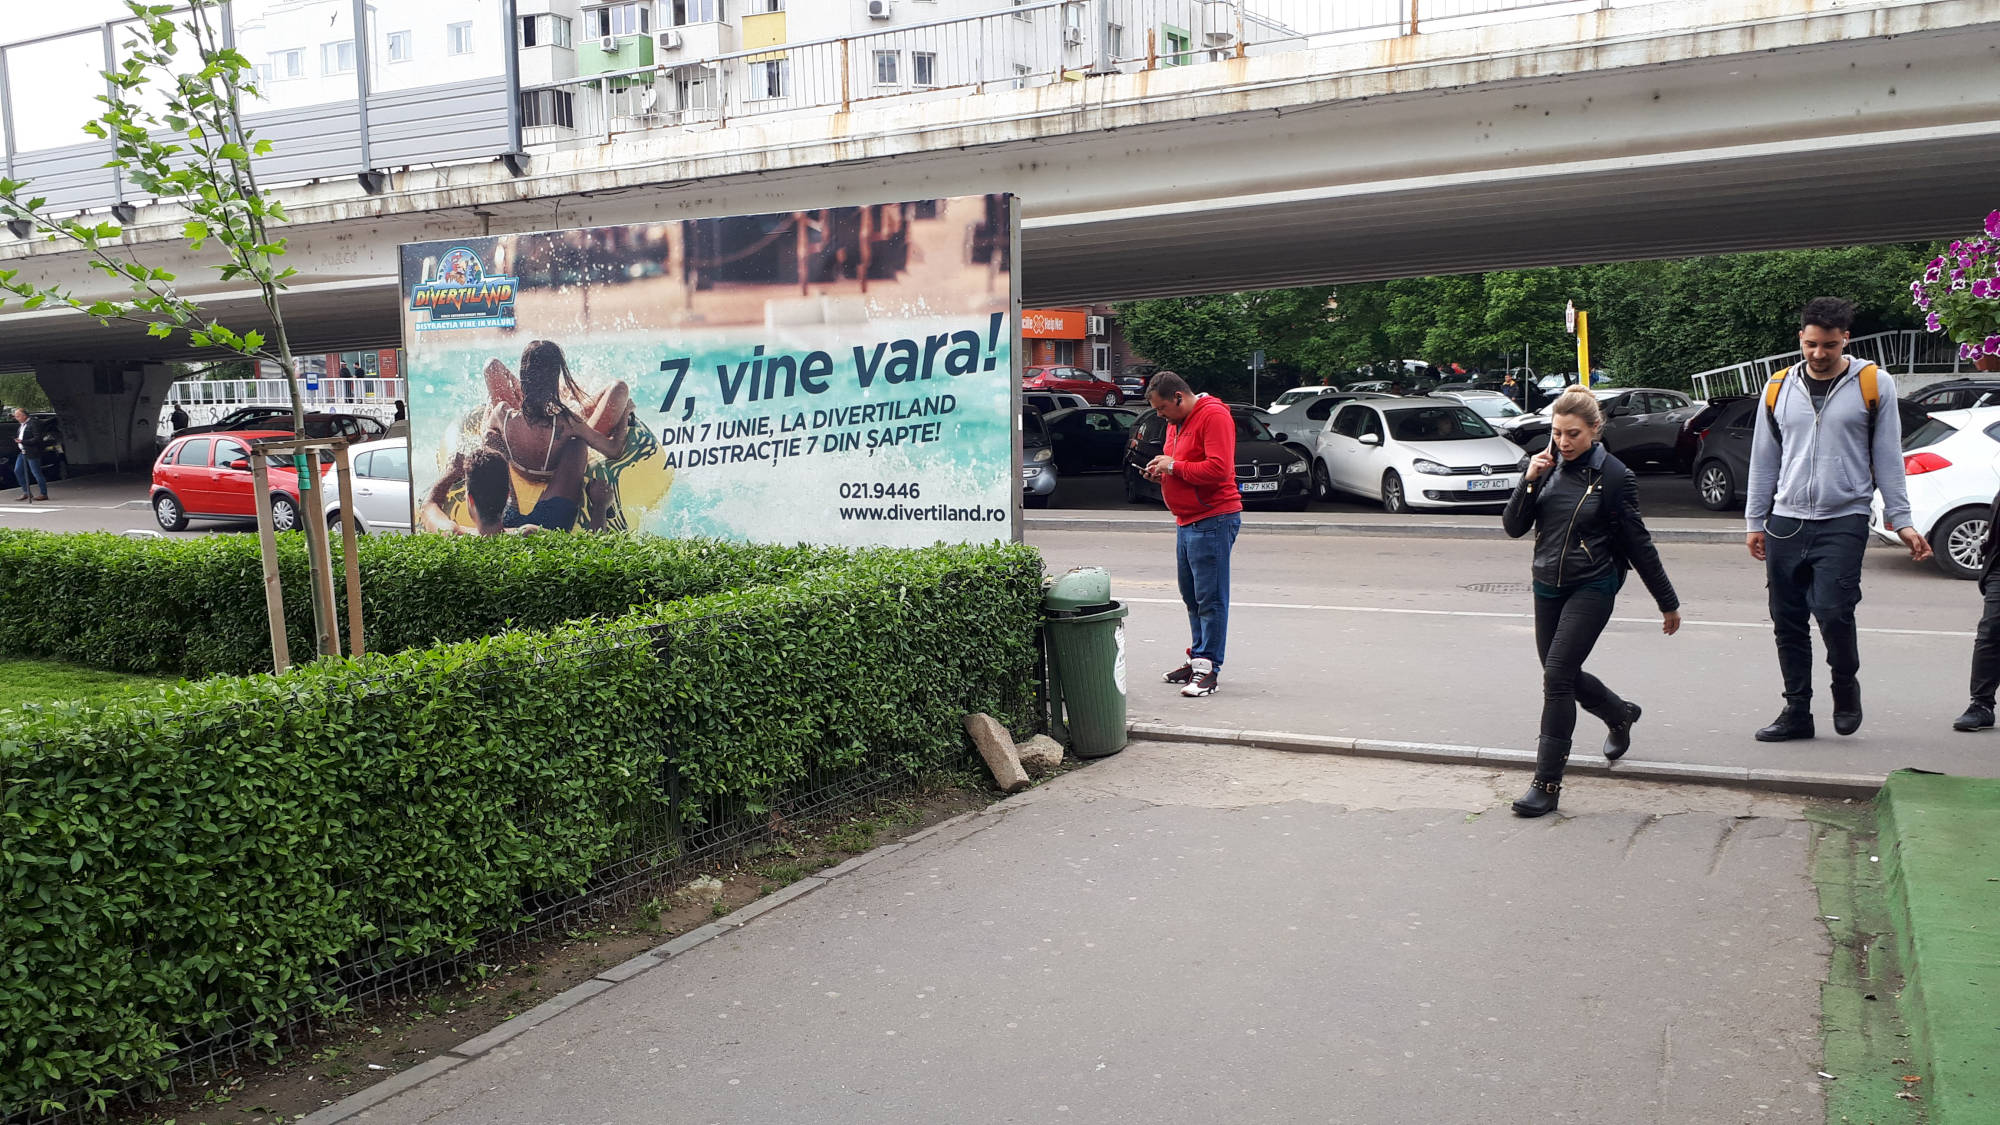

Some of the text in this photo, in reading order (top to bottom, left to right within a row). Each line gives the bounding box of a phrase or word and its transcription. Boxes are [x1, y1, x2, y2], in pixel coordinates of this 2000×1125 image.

[416, 283, 512, 311] DIVERTILAND
[659, 311, 1004, 422] 7, vine vara!
[662, 394, 956, 447] DIN 7 IUNIE, LA DIVERTILAND
[663, 421, 942, 470] AI DISTRACȚIE 7 DIN ȘAPTE!
[839, 482, 920, 499] 021.9446
[1481, 480, 1490, 488] 27
[839, 503, 1006, 522] www.divertiland.ro
